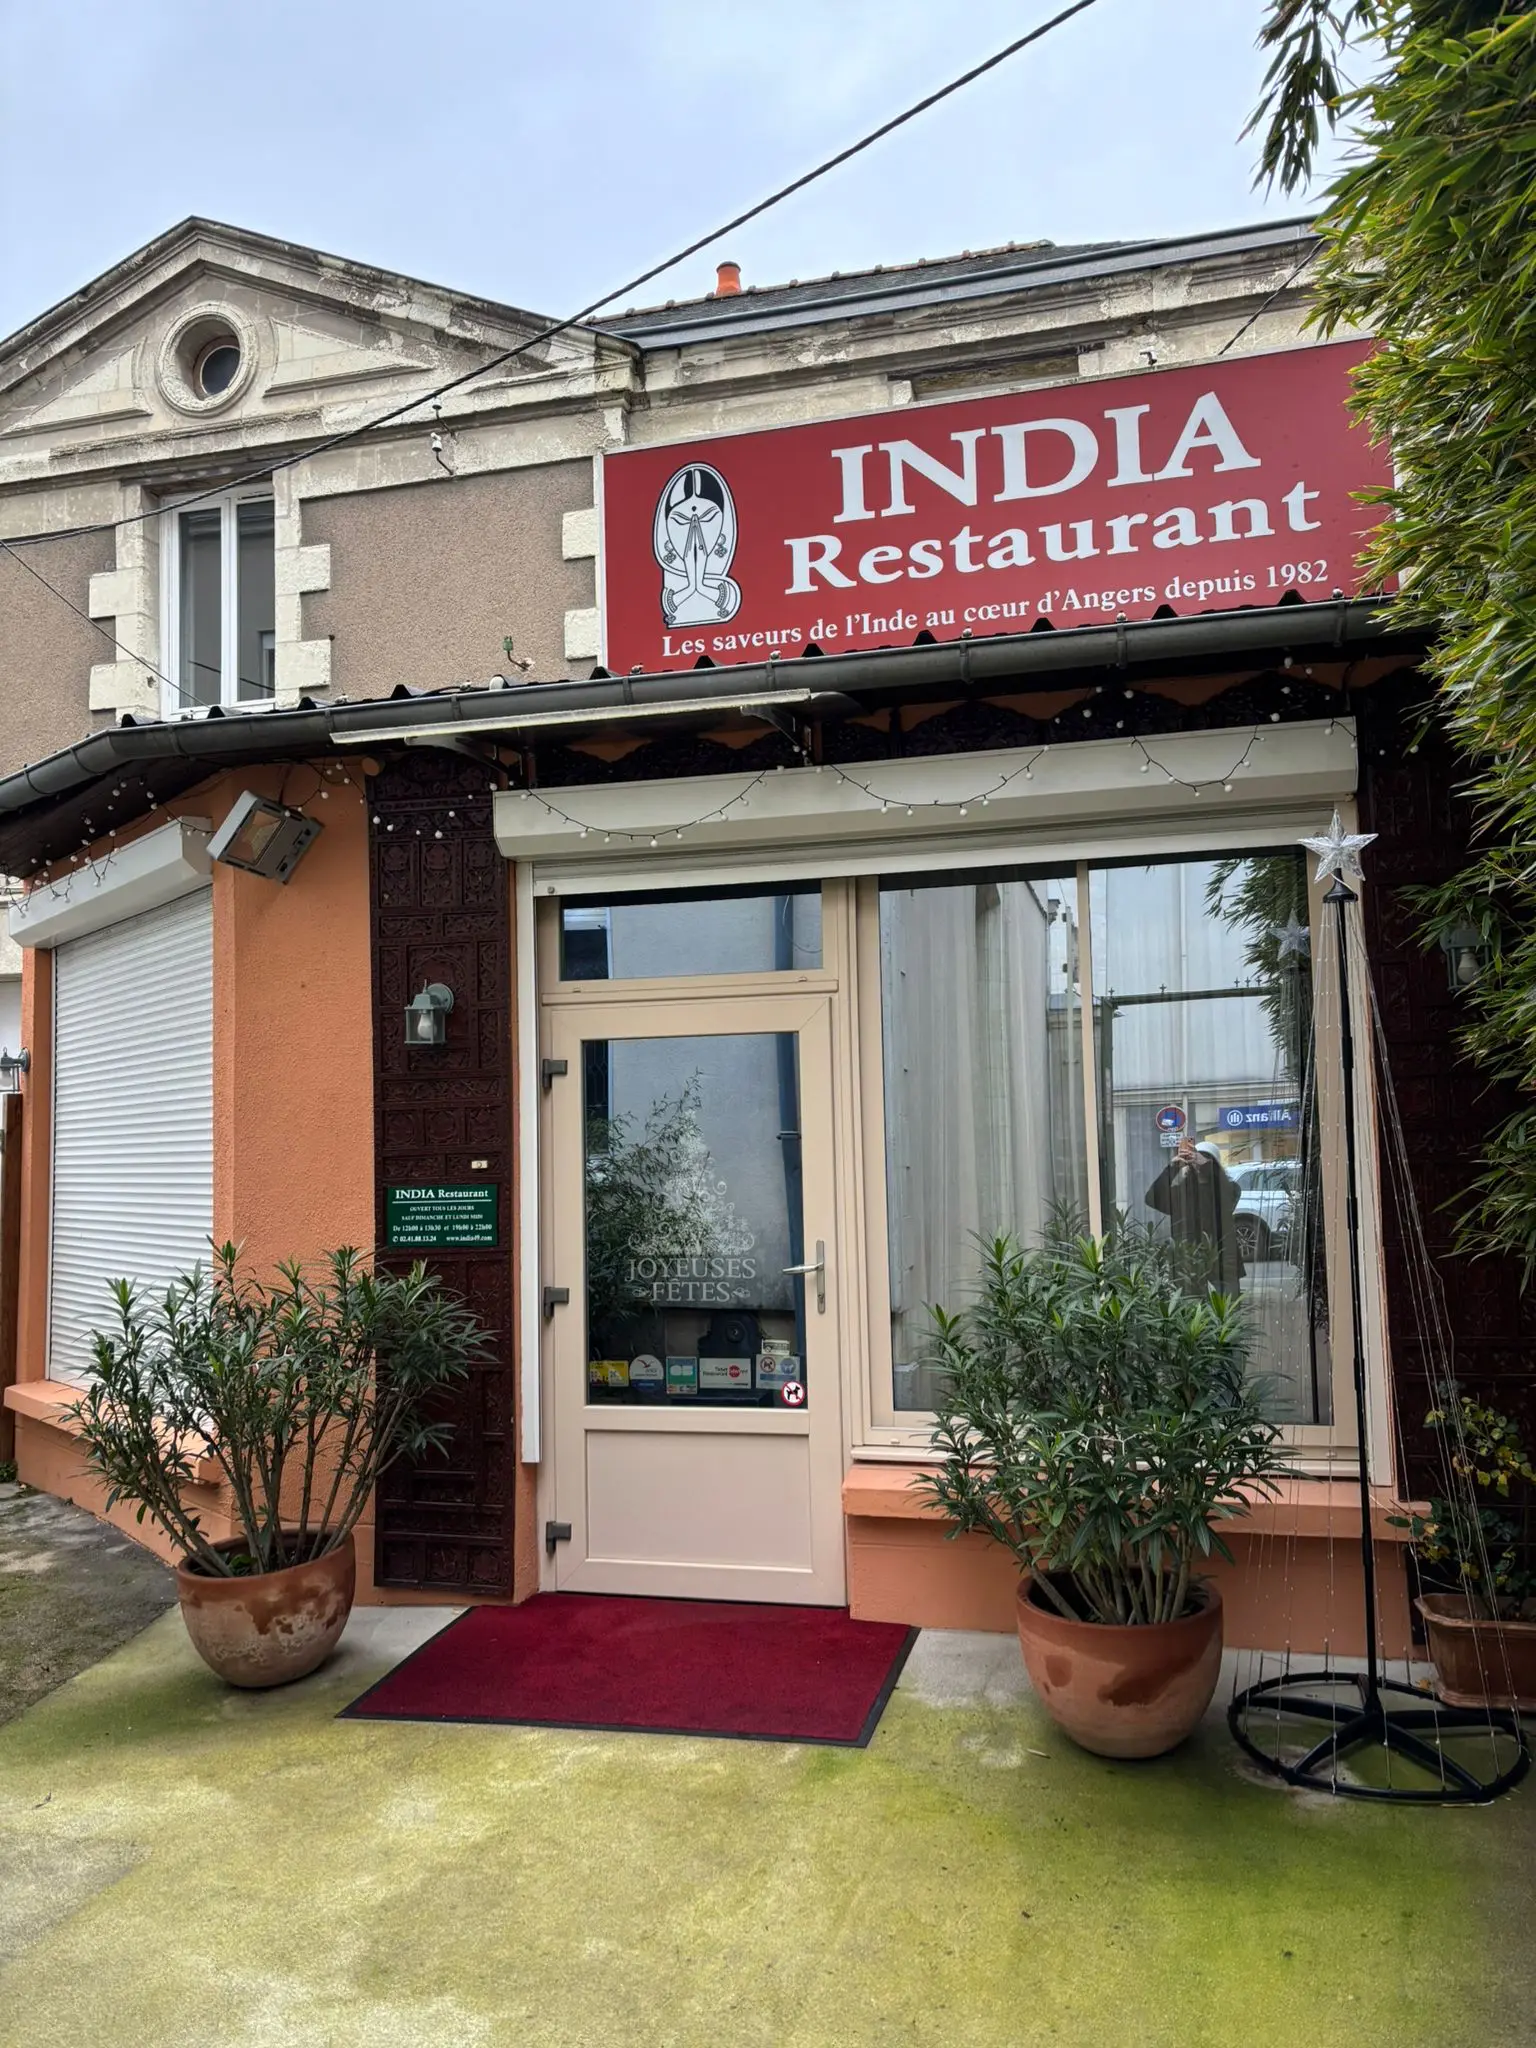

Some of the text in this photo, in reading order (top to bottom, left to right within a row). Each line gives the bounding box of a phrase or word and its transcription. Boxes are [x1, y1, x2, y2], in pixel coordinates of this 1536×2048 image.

[831, 392, 1261, 523] INDIA
[784, 481, 1322, 595] Restaurant
[662, 560, 1329, 657] Les saveurs de l’Inde au cœur d’Angers depuis 1982
[395, 1189, 489, 1199] INDIA Restaurant
[625, 1258, 756, 1281] JOYEUSES
[650, 1278, 731, 1302] FÊTES
